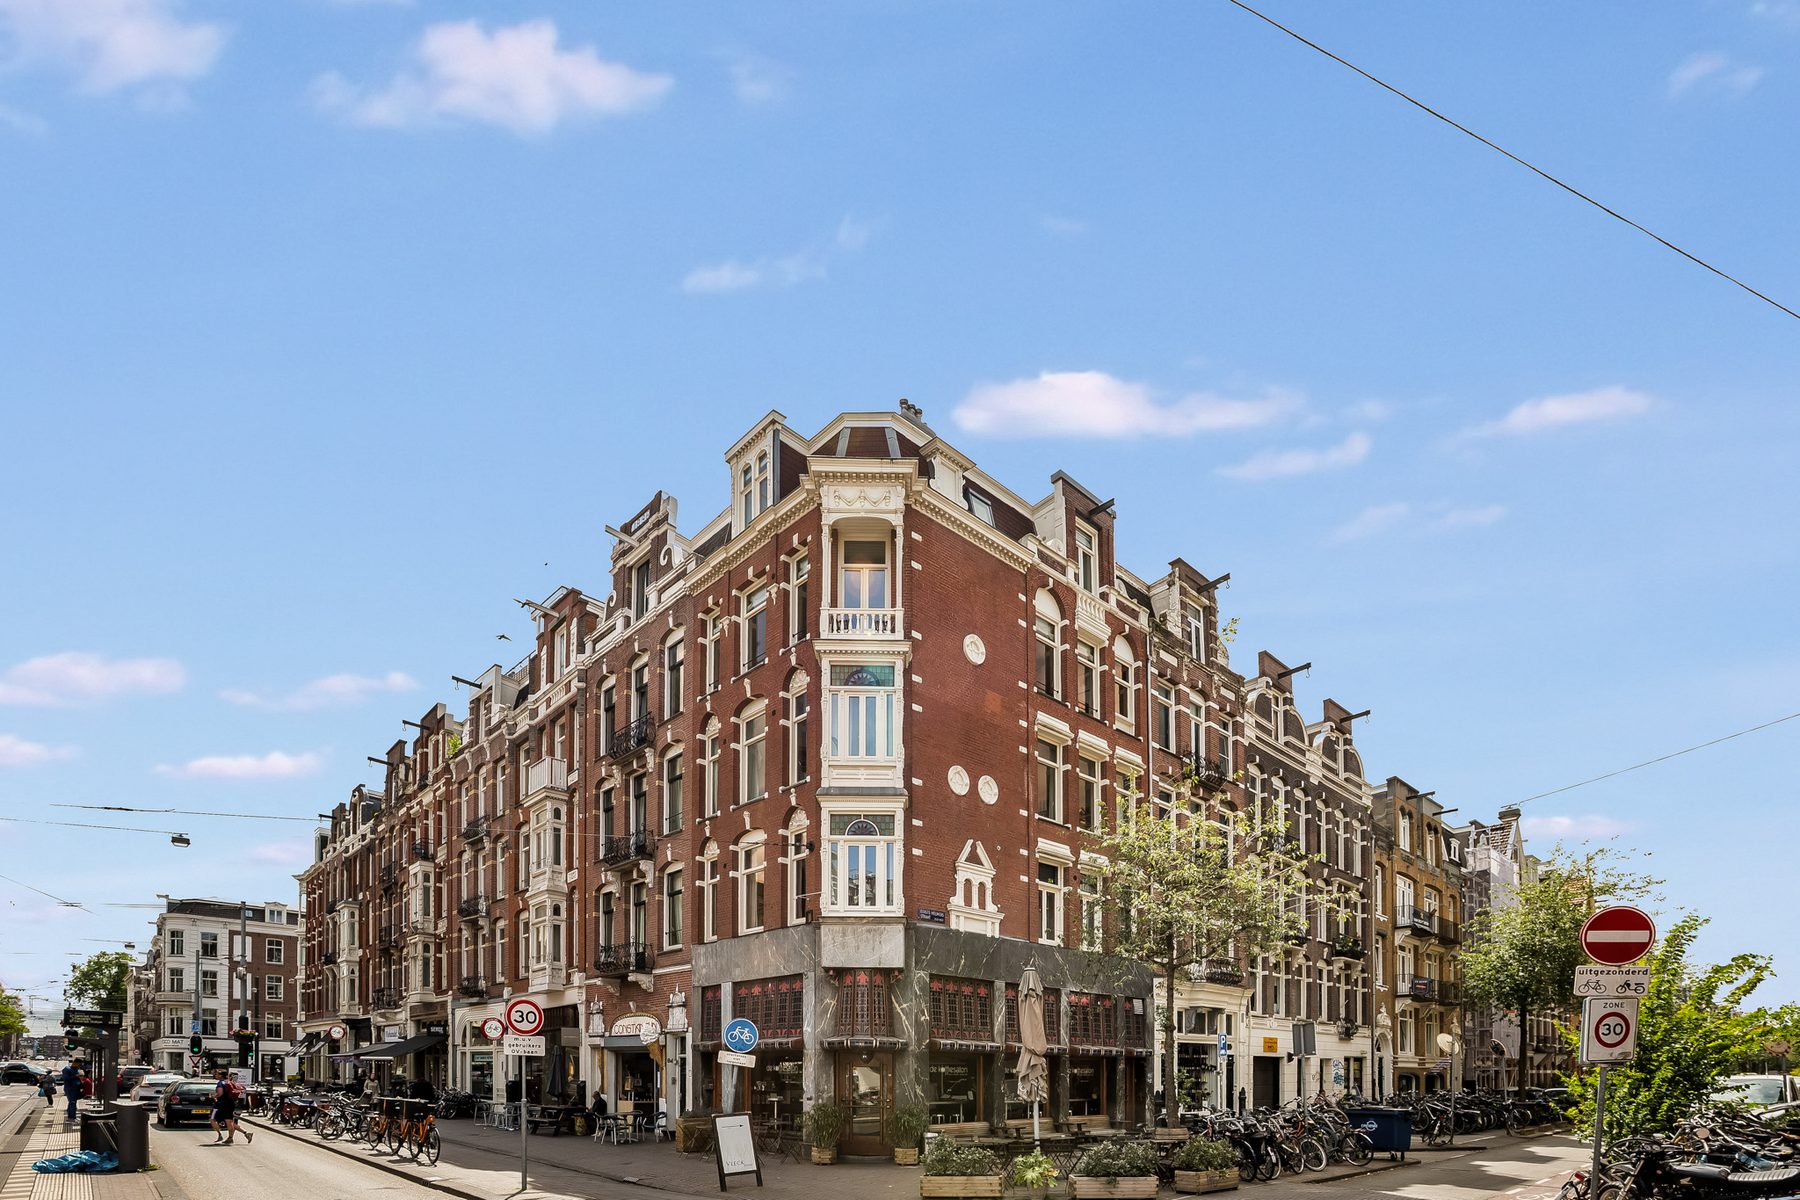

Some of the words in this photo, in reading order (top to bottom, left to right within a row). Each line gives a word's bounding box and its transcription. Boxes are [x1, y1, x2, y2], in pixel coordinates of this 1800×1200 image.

[1578, 968, 1649, 977] uitgezonderd
[513, 1010, 537, 1024] 30
[1601, 1023, 1624, 1036] 30
[1220, 1035, 1226, 1048] P
